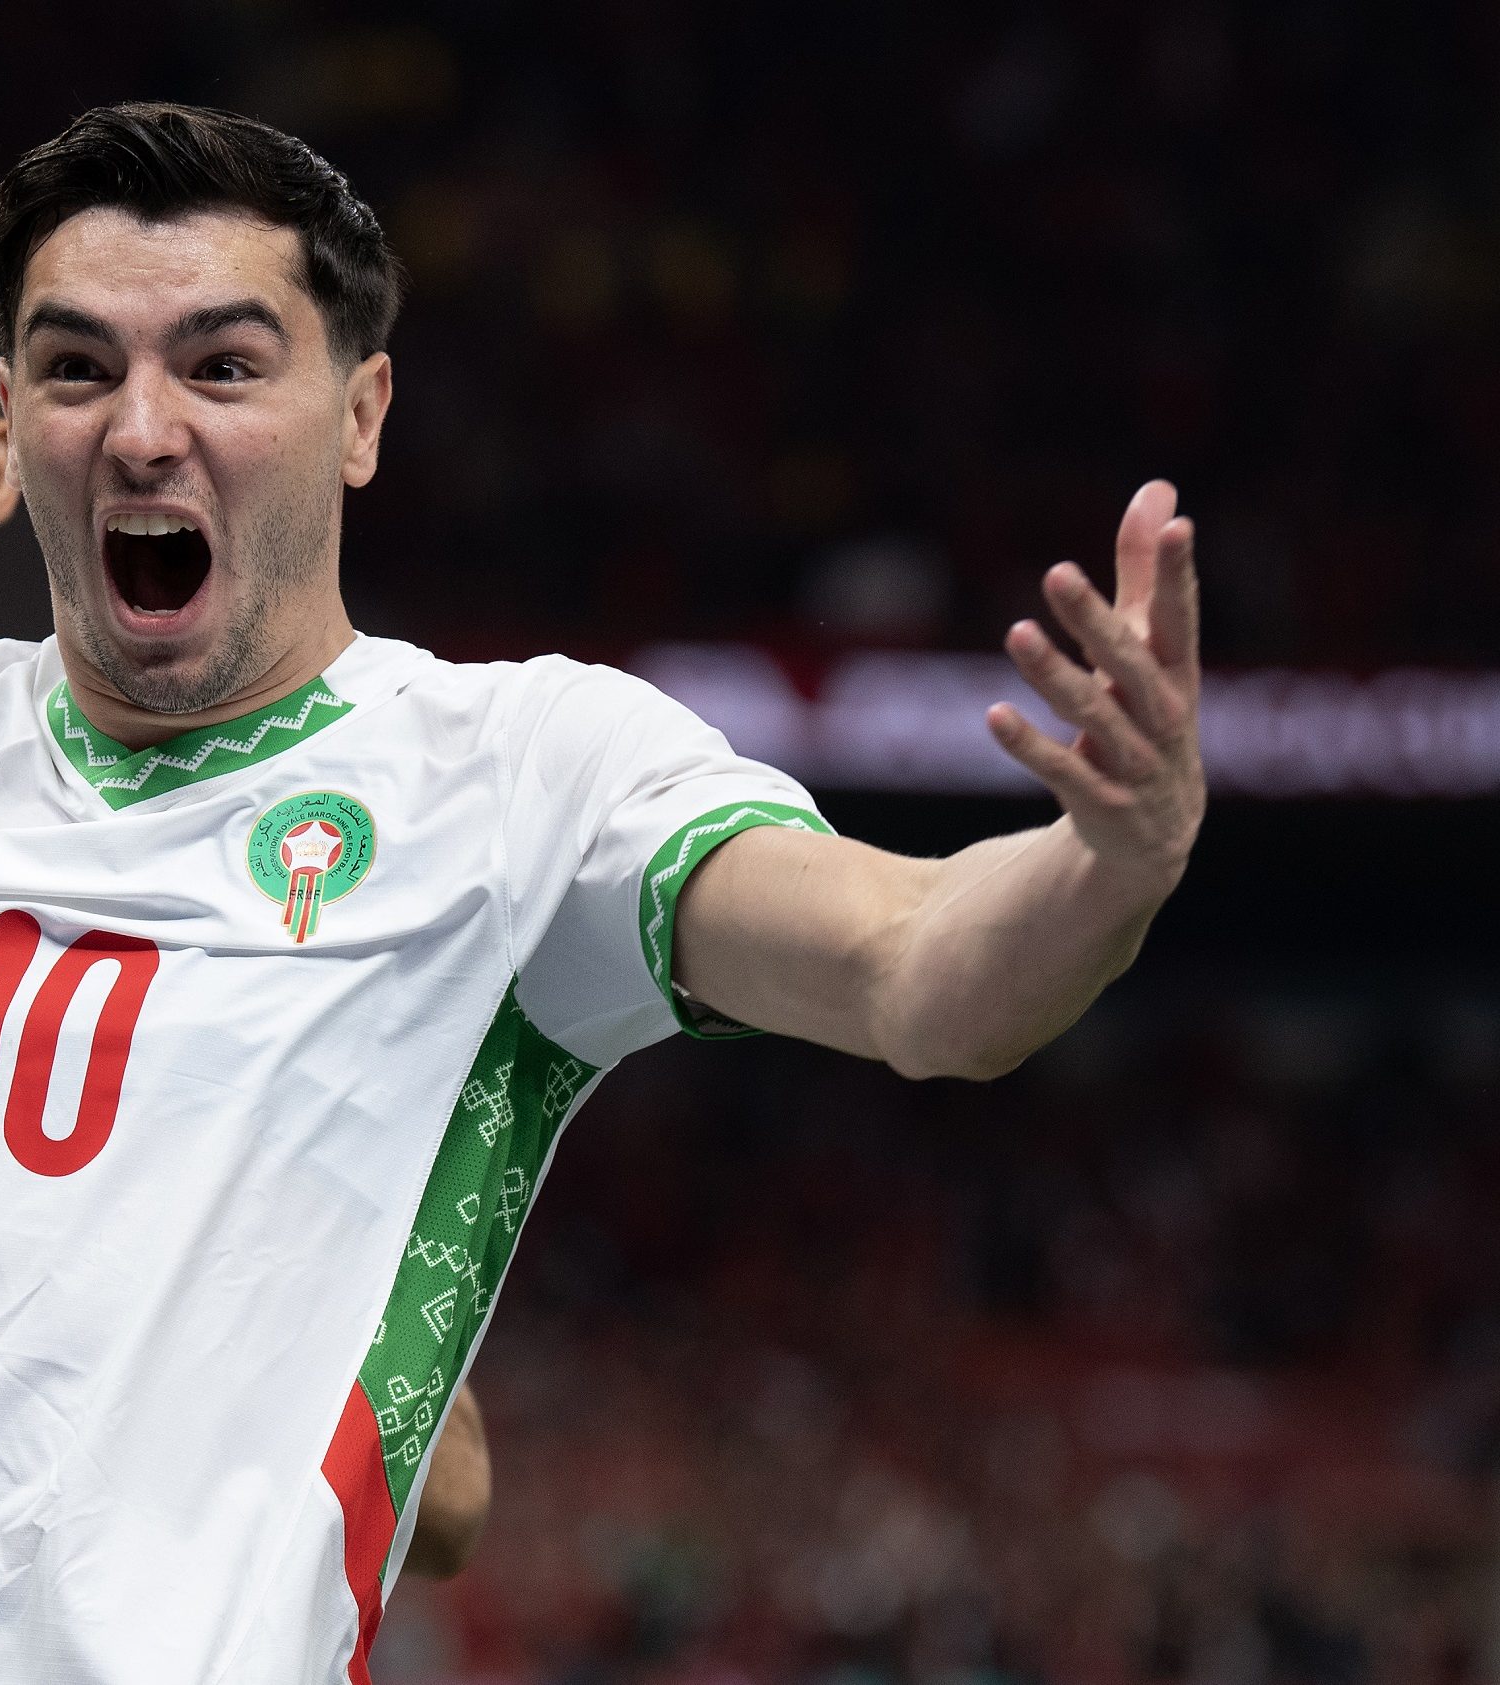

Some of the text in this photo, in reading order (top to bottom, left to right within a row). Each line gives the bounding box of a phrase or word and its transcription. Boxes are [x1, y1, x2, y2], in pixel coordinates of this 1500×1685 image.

[277, 813, 306, 836] ROYALE
[307, 811, 350, 832] MAROCAINE
[336, 797, 370, 828] الملكية
[345, 831, 353, 841] DE
[328, 842, 353, 879] FOOTBALL
[347, 833, 373, 883] الجامعة
